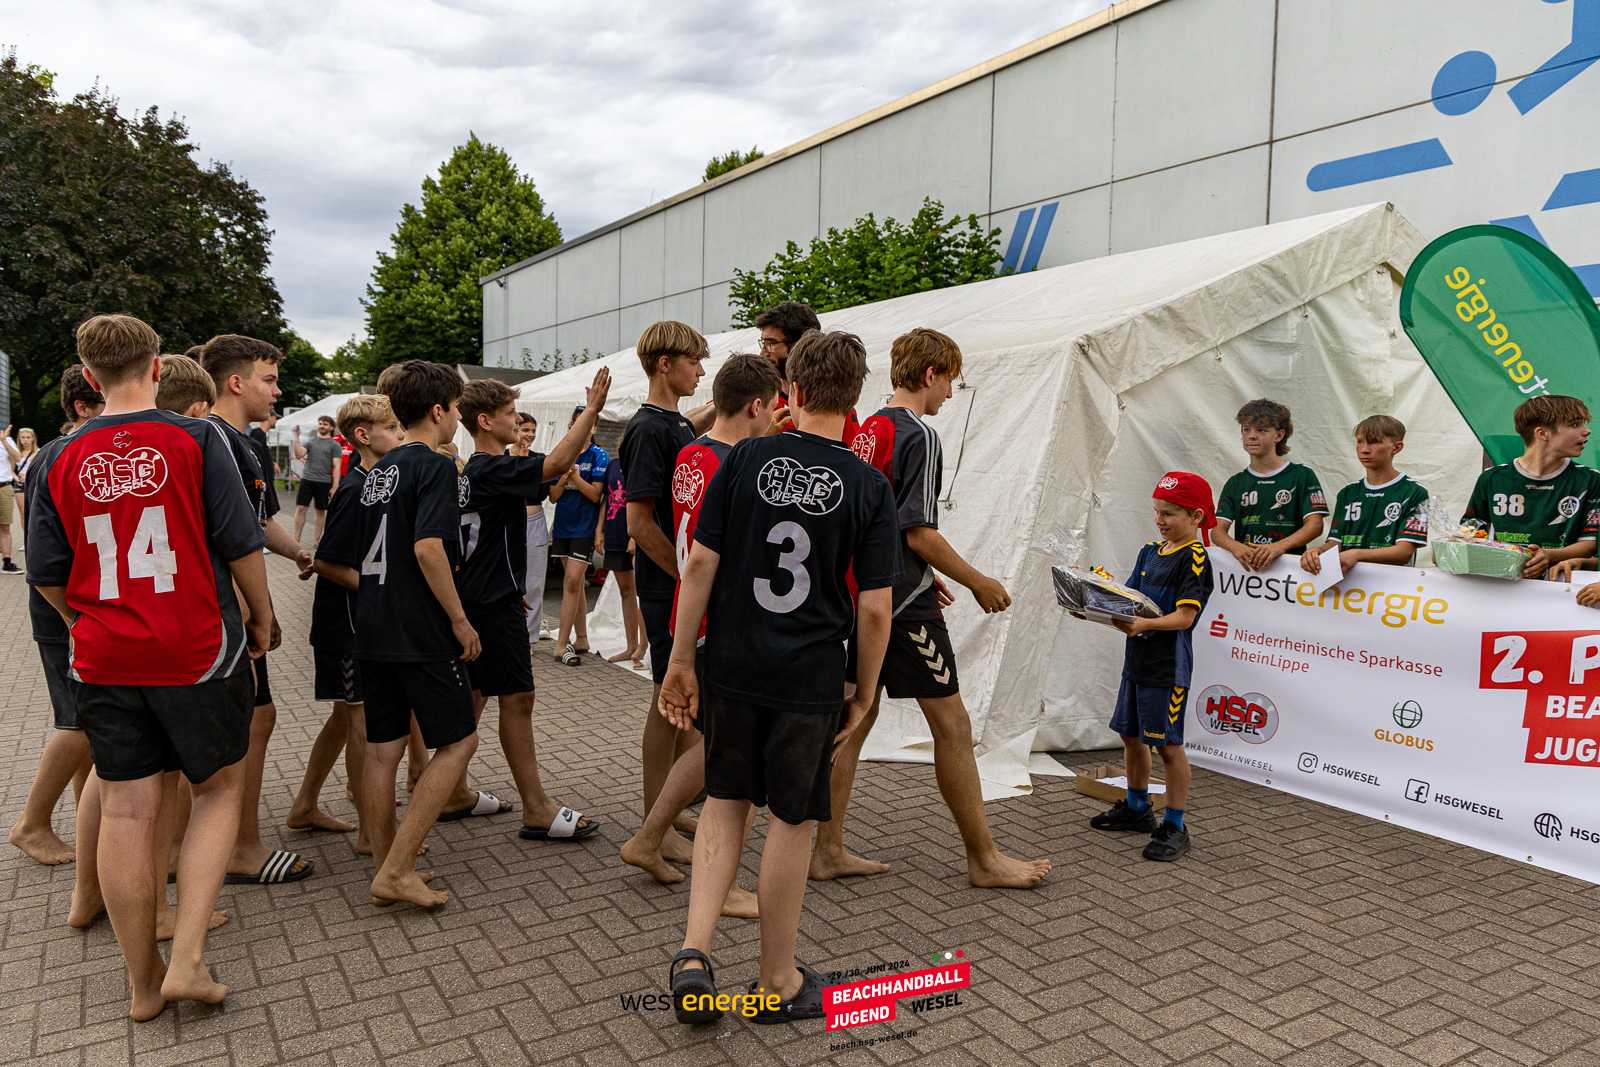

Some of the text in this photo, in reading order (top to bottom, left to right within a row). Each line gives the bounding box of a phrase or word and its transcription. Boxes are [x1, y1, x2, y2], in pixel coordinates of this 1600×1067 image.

[98, 477, 148, 497] WESEL
[767, 466, 833, 501] HSG
[770, 488, 817, 505] WESEL
[1240, 490, 1259, 507] 50
[1344, 502, 1363, 521] 15
[1492, 493, 1525, 516] 38
[84, 505, 178, 600] 14
[361, 513, 388, 585] 4
[753, 520, 811, 614] 3
[1219, 571, 1449, 628] westenergie
[1231, 646, 1310, 673] RheinLippe
[1233, 628, 1444, 677] Niederrheinische Sparkasse
[1491, 635, 1544, 684] 2.
[1206, 695, 1268, 729] HSG
[1143, 729, 1166, 740] hummel
[1210, 717, 1260, 736] WESEL
[1374, 728, 1434, 751] GLOBUS
[1185, 741, 1274, 772] #HANDBALLINWESEL
[1533, 736, 1600, 763] JUG
[1322, 762, 1381, 787] HSGWESEL
[1434, 792, 1504, 820] HSGWESEL
